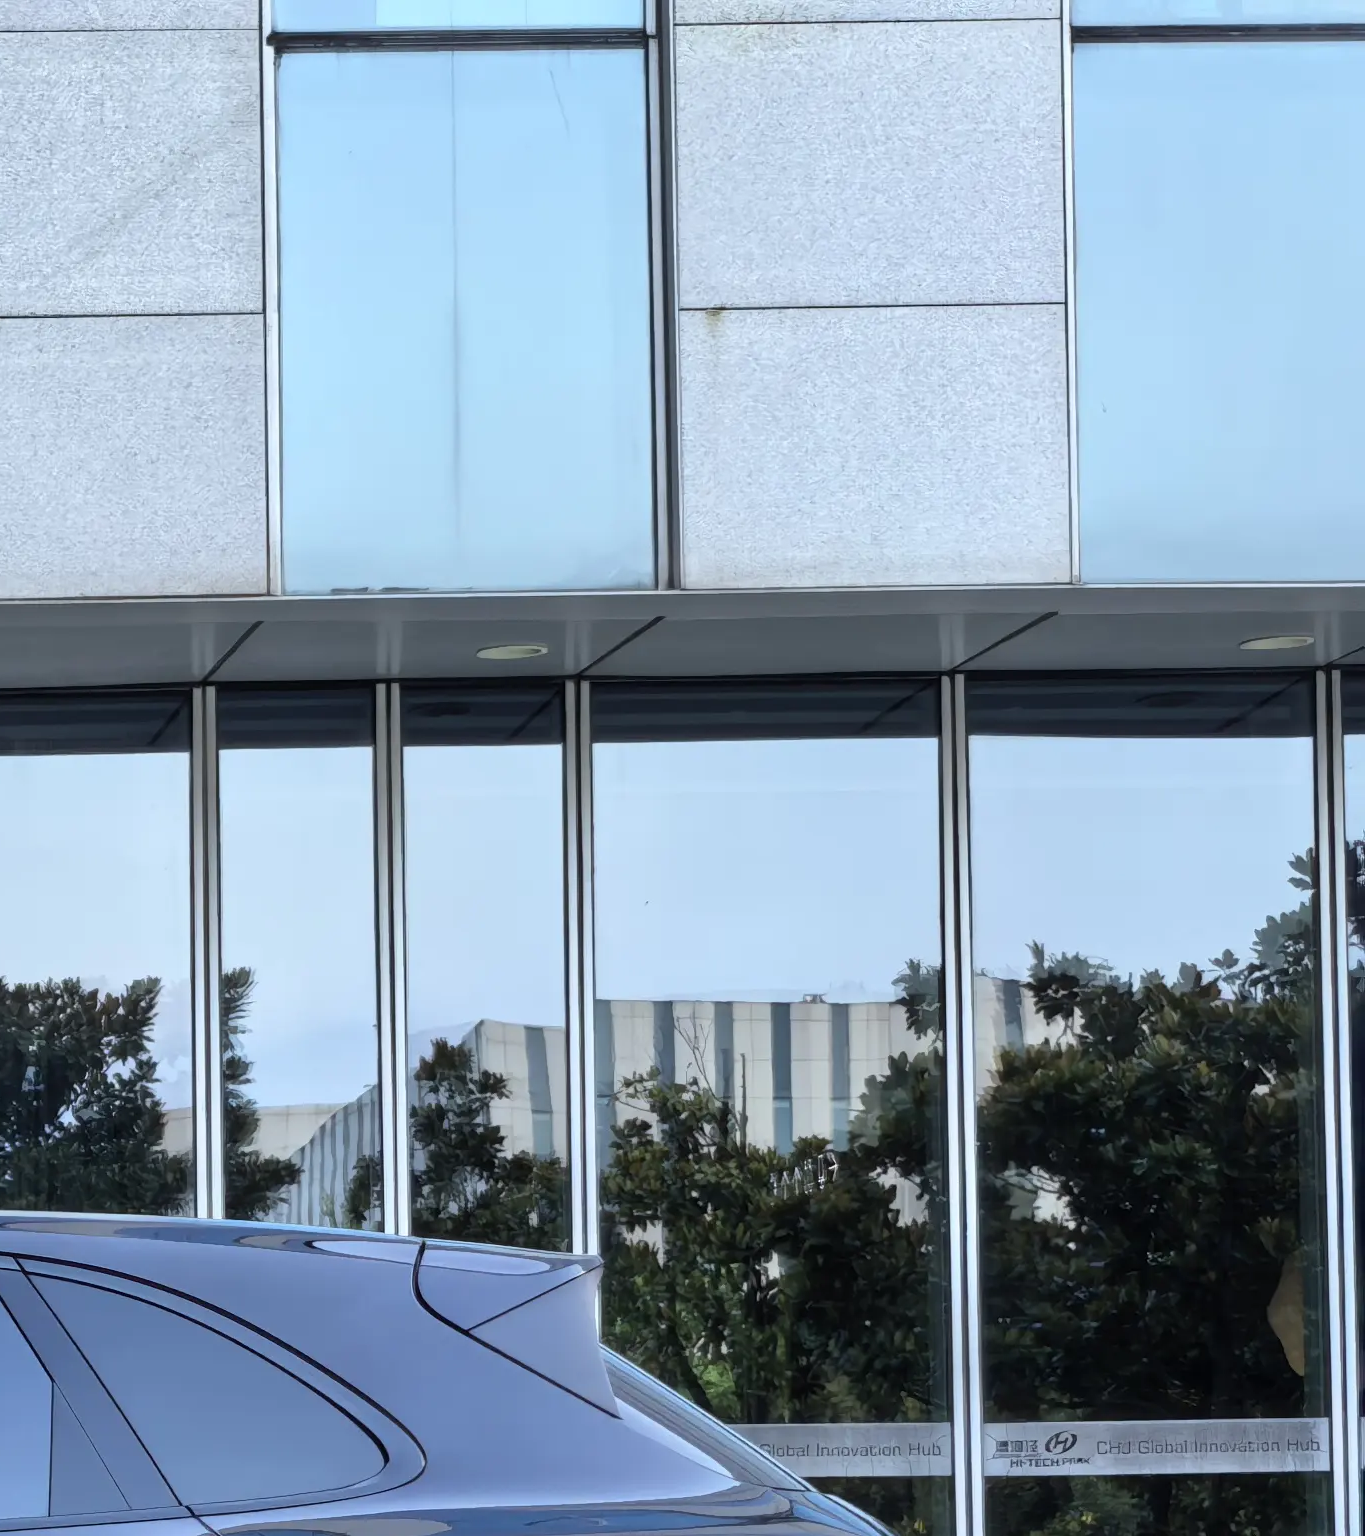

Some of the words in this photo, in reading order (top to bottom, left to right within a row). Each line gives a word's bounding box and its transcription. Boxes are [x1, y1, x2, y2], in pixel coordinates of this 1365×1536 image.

[816, 1443, 902, 1457] Innovation
[908, 1442, 941, 1456] Hub
[1138, 1439, 1188, 1454] Global
[1194, 1439, 1281, 1453] Innovation
[1287, 1437, 1321, 1452] Hub
